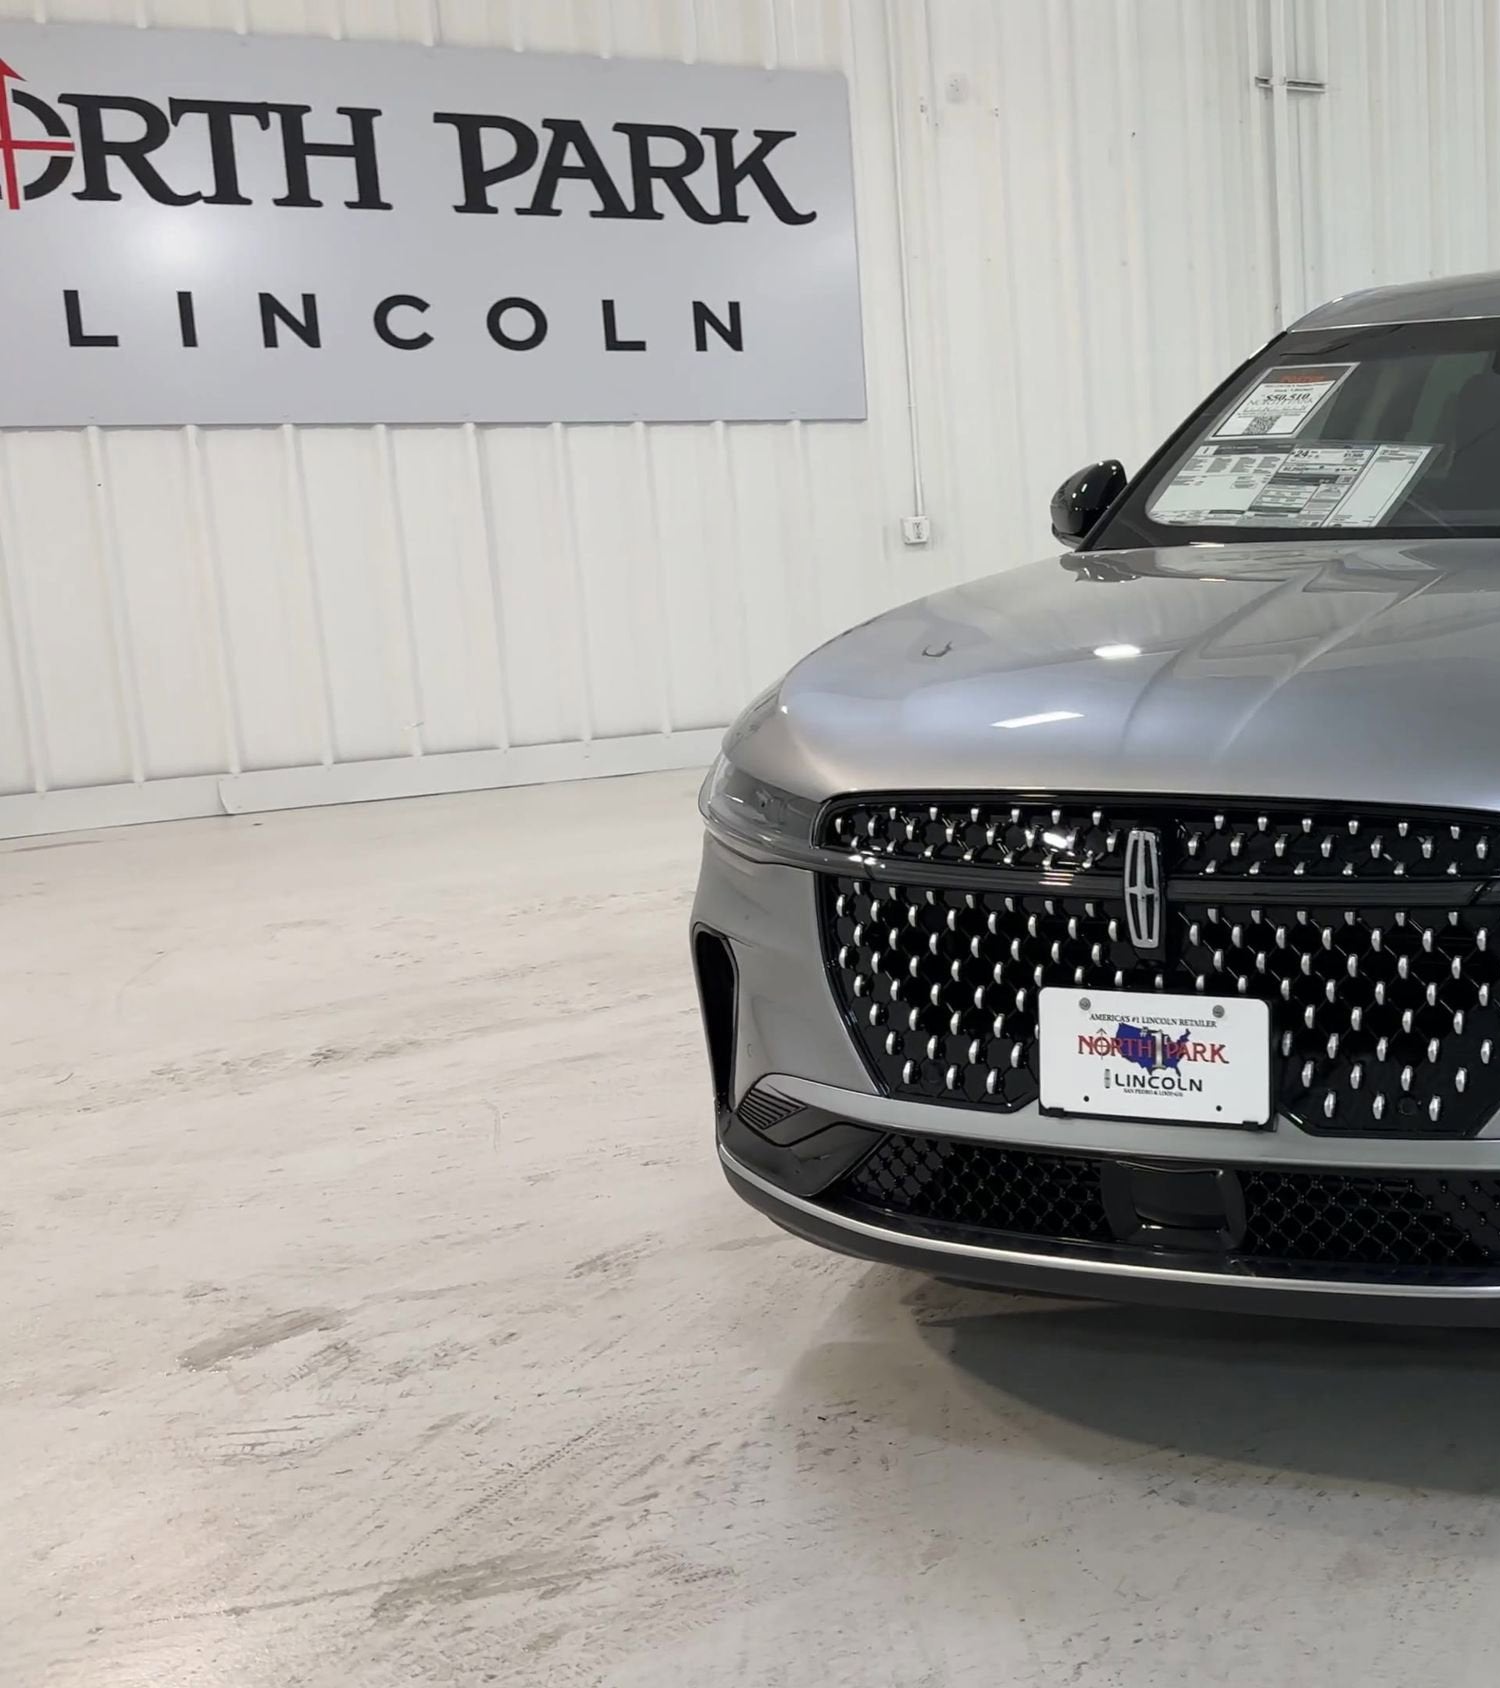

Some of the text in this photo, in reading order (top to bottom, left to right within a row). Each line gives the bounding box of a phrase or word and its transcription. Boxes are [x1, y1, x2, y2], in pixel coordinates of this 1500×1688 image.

[433, 112, 817, 226] PARK
[63, 289, 744, 352] LINCOLN
[1089, 1013, 1130, 1023] AMERICA'S
[1142, 1016, 1178, 1026] LINCOLN
[1179, 1018, 1217, 1028] RETAILER
[1078, 1034, 1230, 1064] NORTH PARK
[1115, 1073, 1203, 1092] LINCOLN
